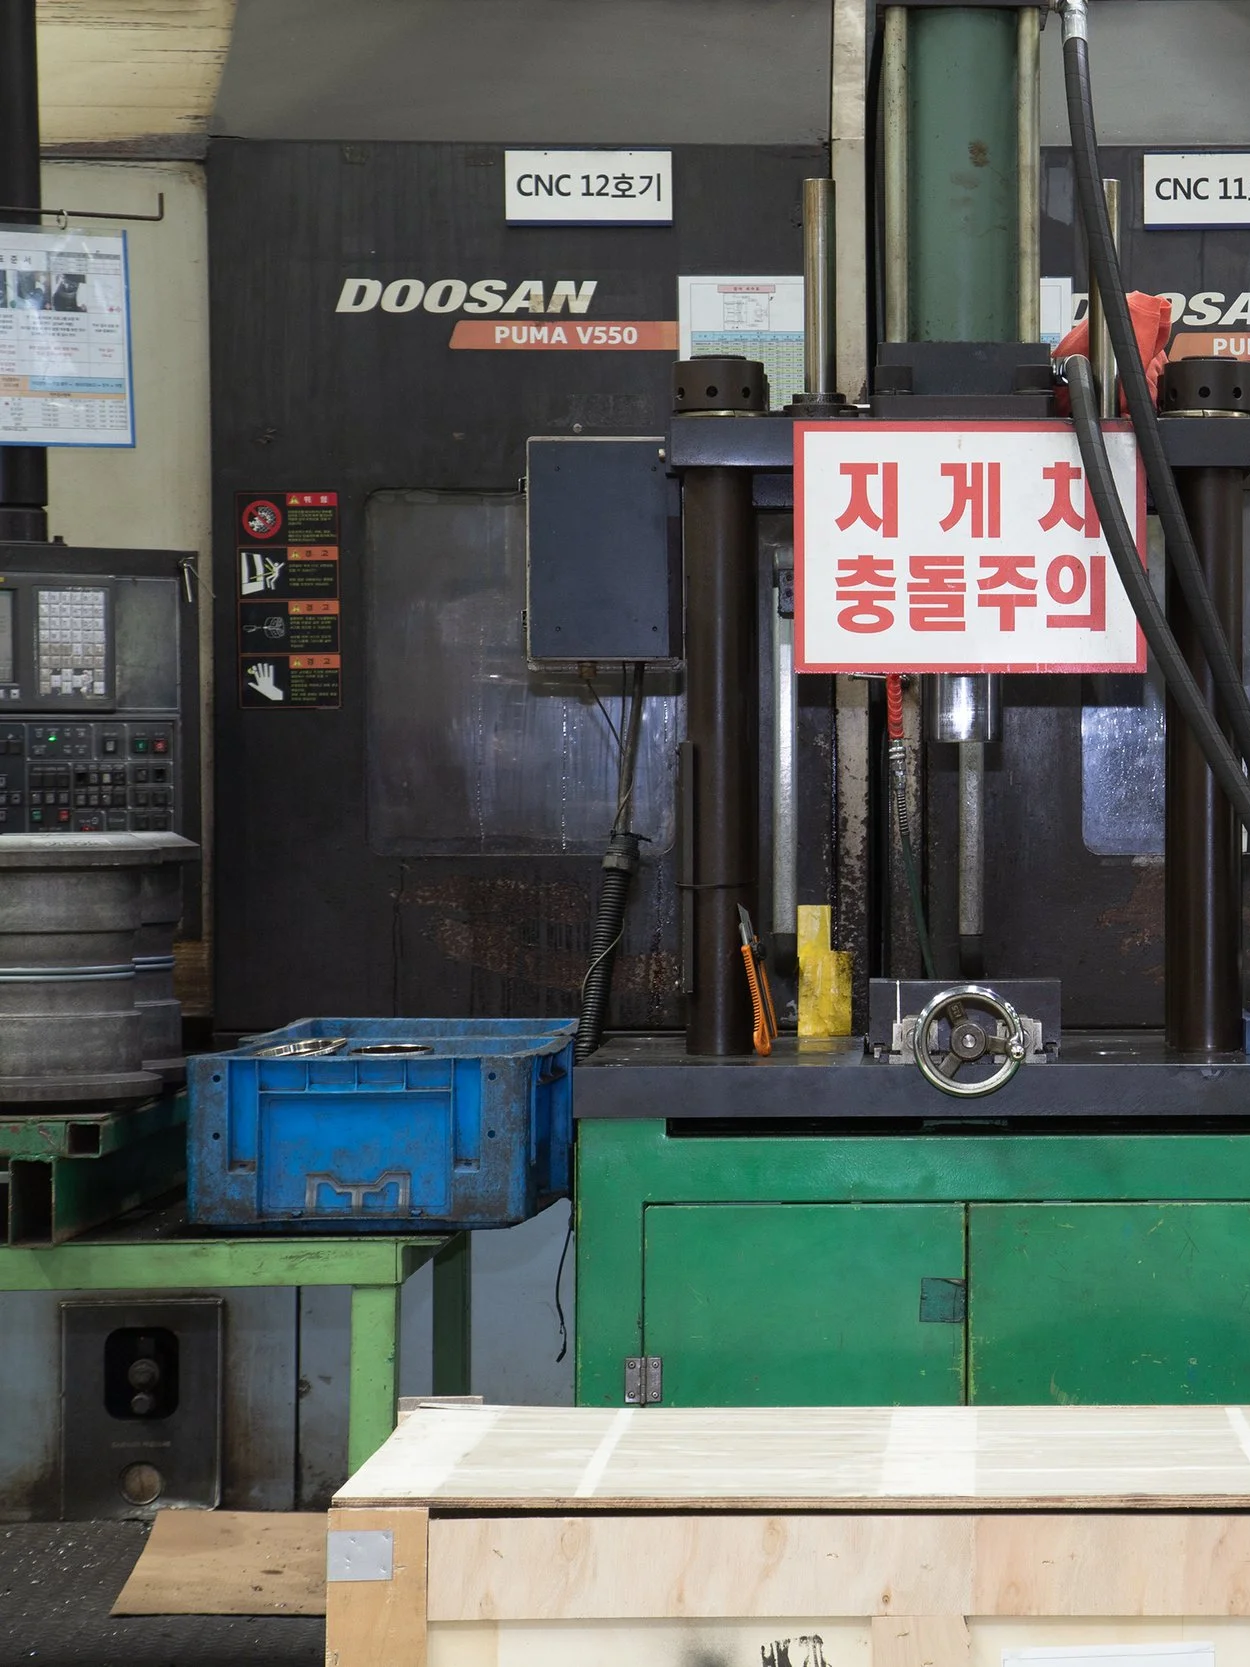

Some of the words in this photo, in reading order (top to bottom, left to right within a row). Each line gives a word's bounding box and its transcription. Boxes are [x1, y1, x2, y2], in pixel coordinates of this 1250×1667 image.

[516, 173, 572, 198] CNC
[580, 172, 663, 202] 12호기
[1155, 177, 1210, 201] CNC
[336, 277, 598, 314] DOOSAN
[494, 326, 568, 345] PUMA
[575, 325, 639, 346] V550
[835, 554, 1106, 633] 충돌주의
